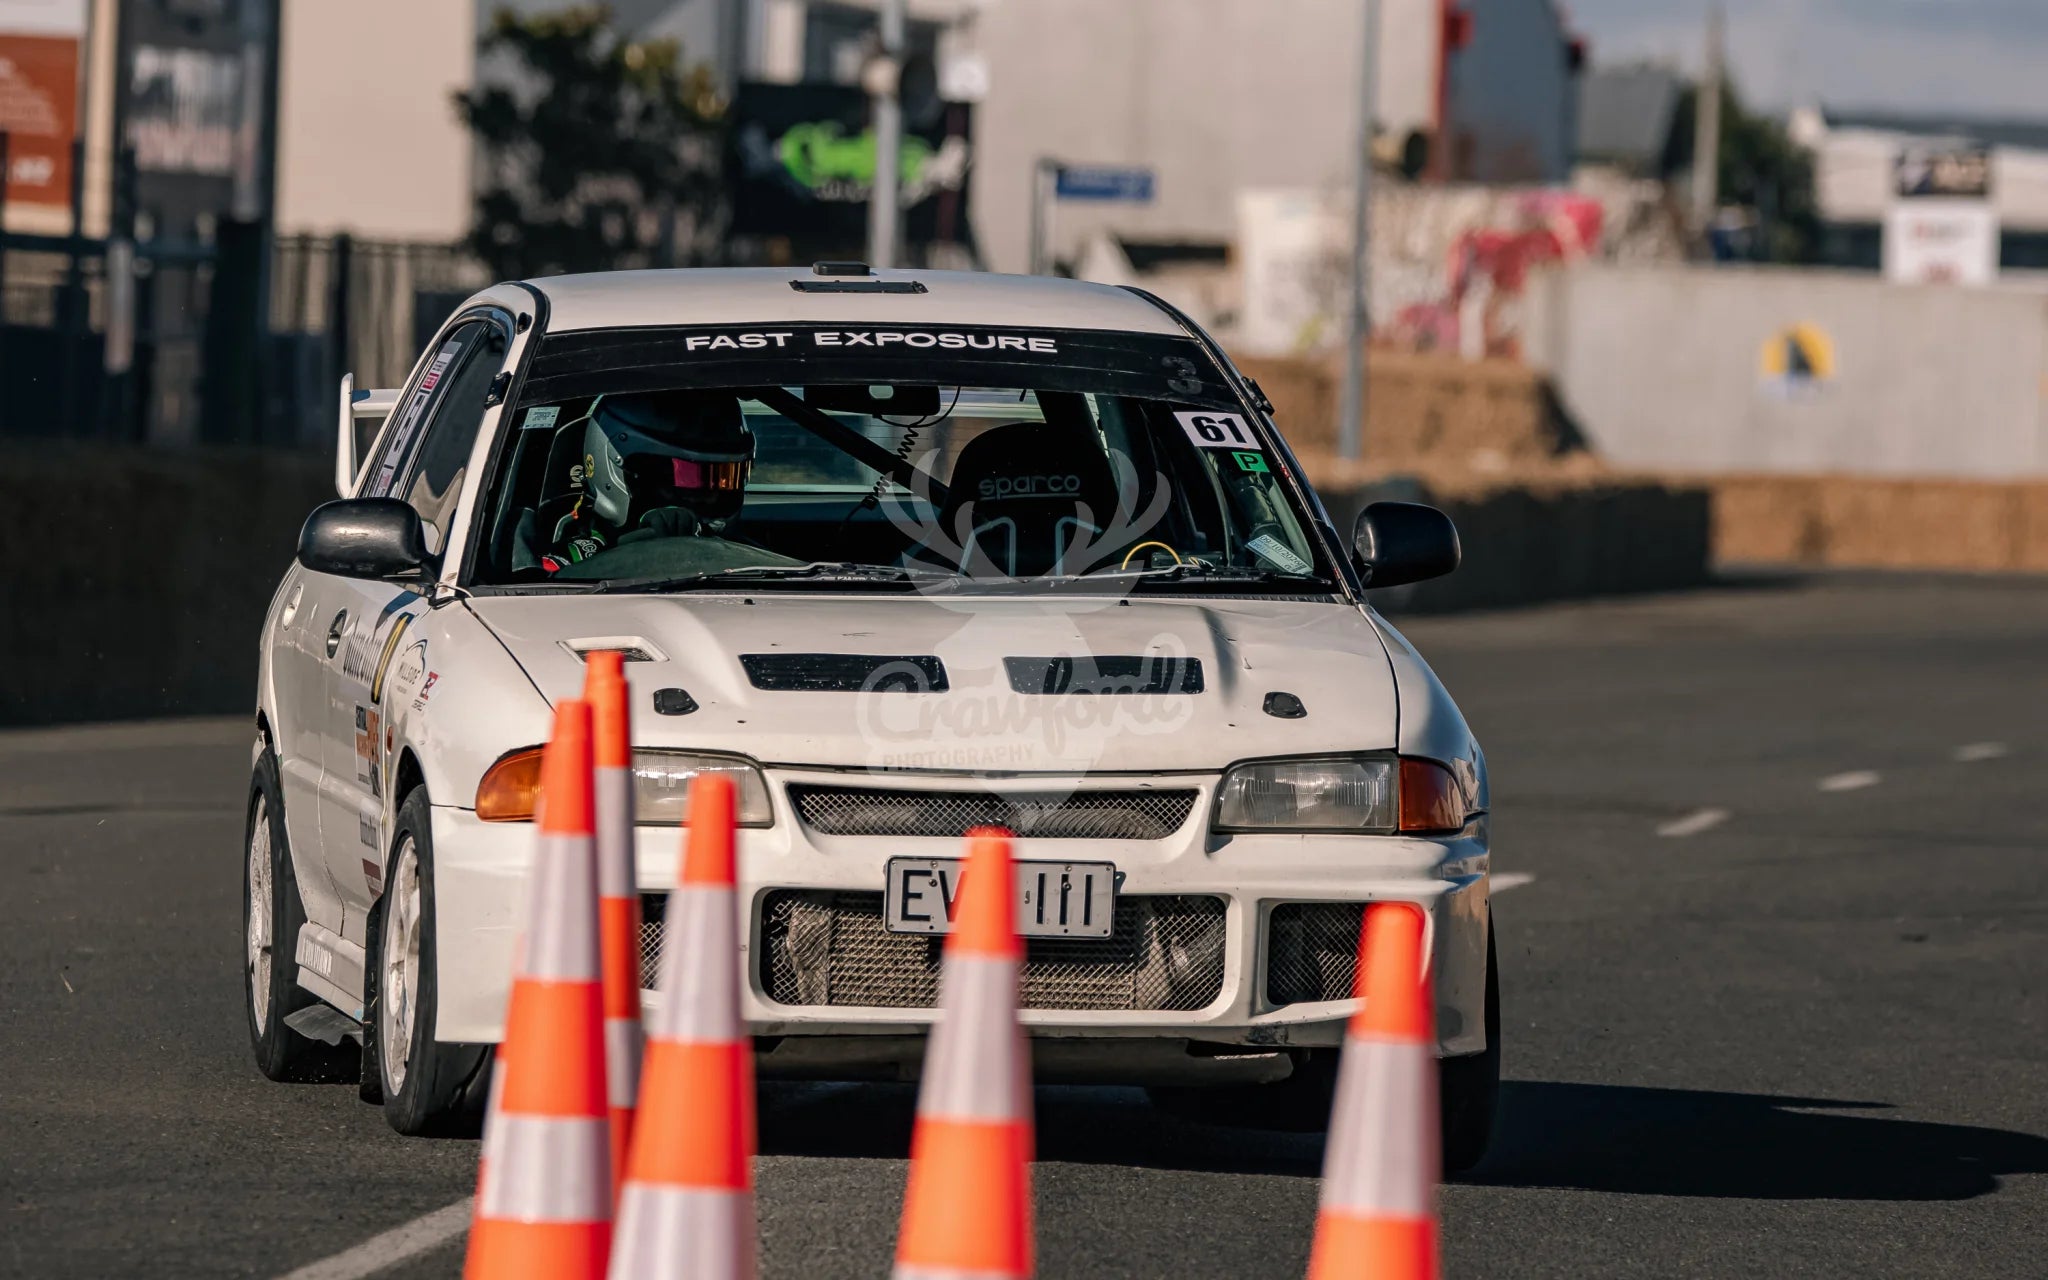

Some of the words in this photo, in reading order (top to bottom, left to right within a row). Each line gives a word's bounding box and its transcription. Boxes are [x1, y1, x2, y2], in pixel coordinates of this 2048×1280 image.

[685, 333, 793, 351] FAST
[814, 332, 1058, 353] EXPOSURE
[1190, 415, 1248, 444] 61
[1239, 454, 1259, 467] P
[979, 475, 1080, 500] sparco
[901, 869, 988, 923] EV
